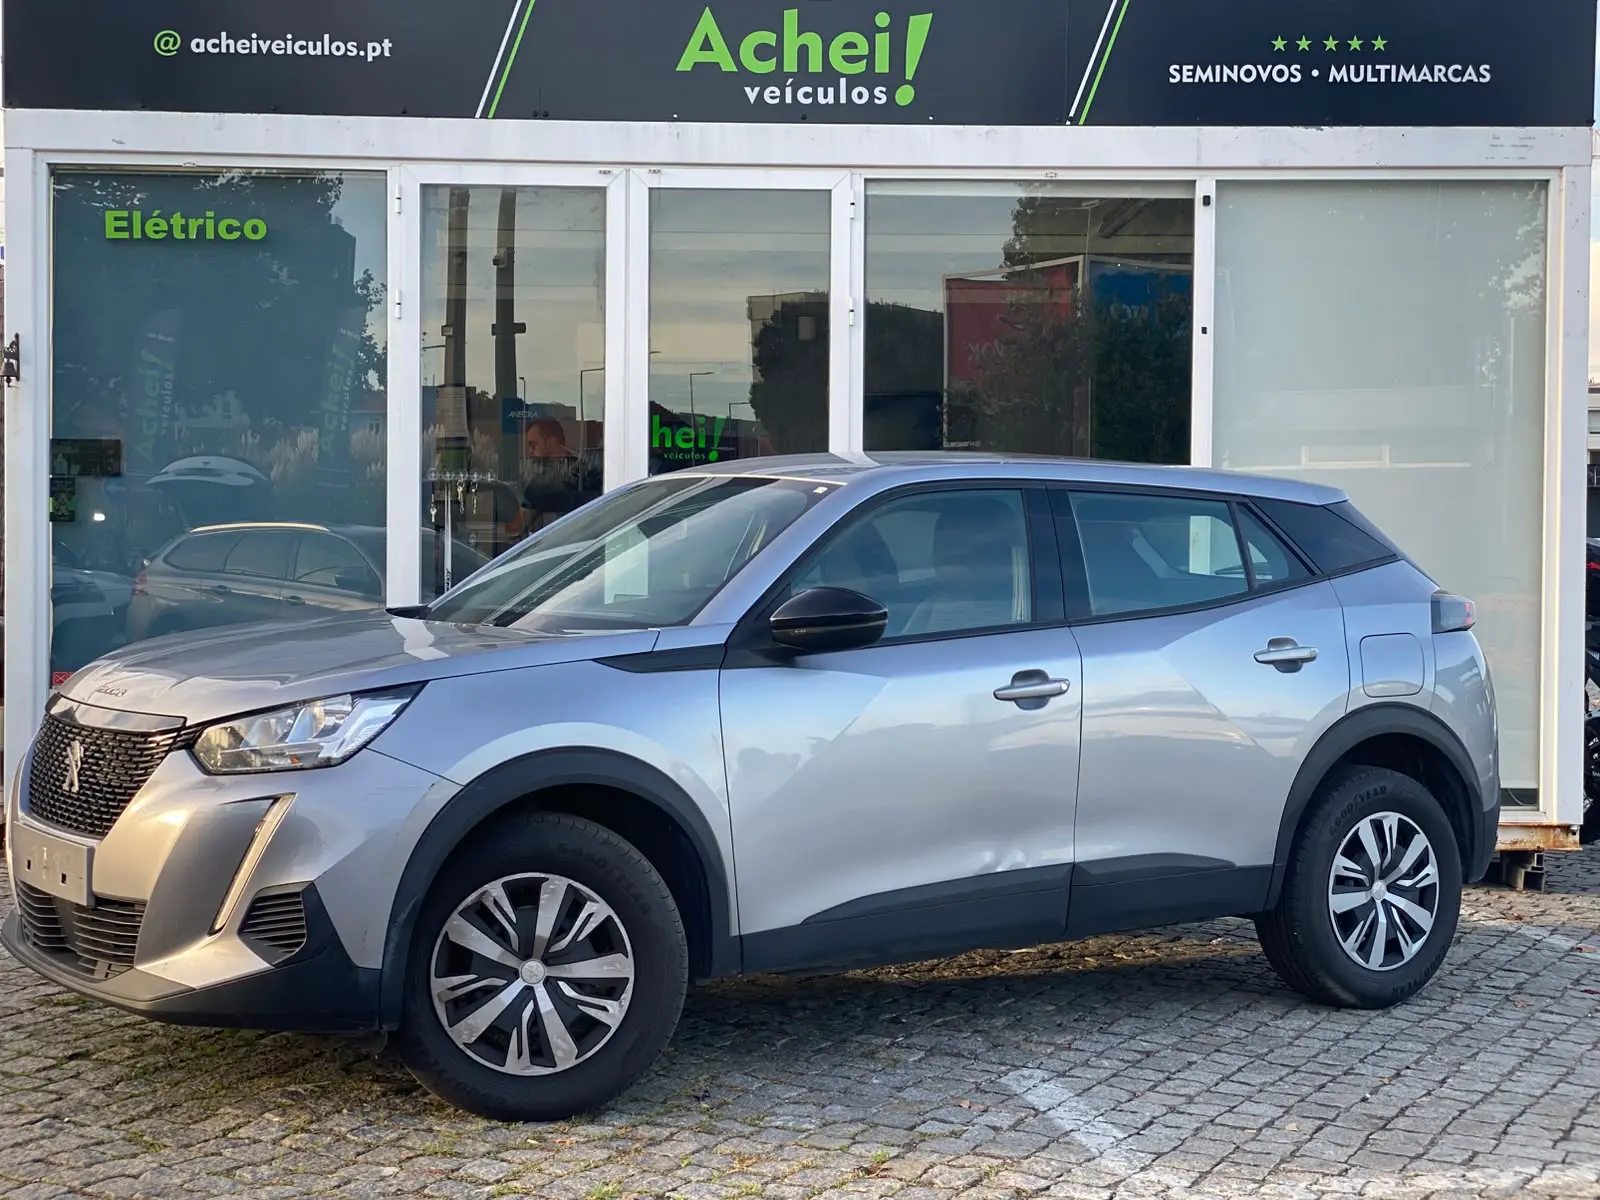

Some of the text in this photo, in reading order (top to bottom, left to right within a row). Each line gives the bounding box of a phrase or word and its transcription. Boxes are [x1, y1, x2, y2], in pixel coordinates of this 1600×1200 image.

[190, 31, 393, 62] acheiveiculos.pt
[675, 6, 934, 107] Achei!
[1168, 63, 1492, 84] SEMINOVOS MULTIMARCAS
[743, 76, 888, 105] veículos
[104, 209, 268, 241] Elétrico
